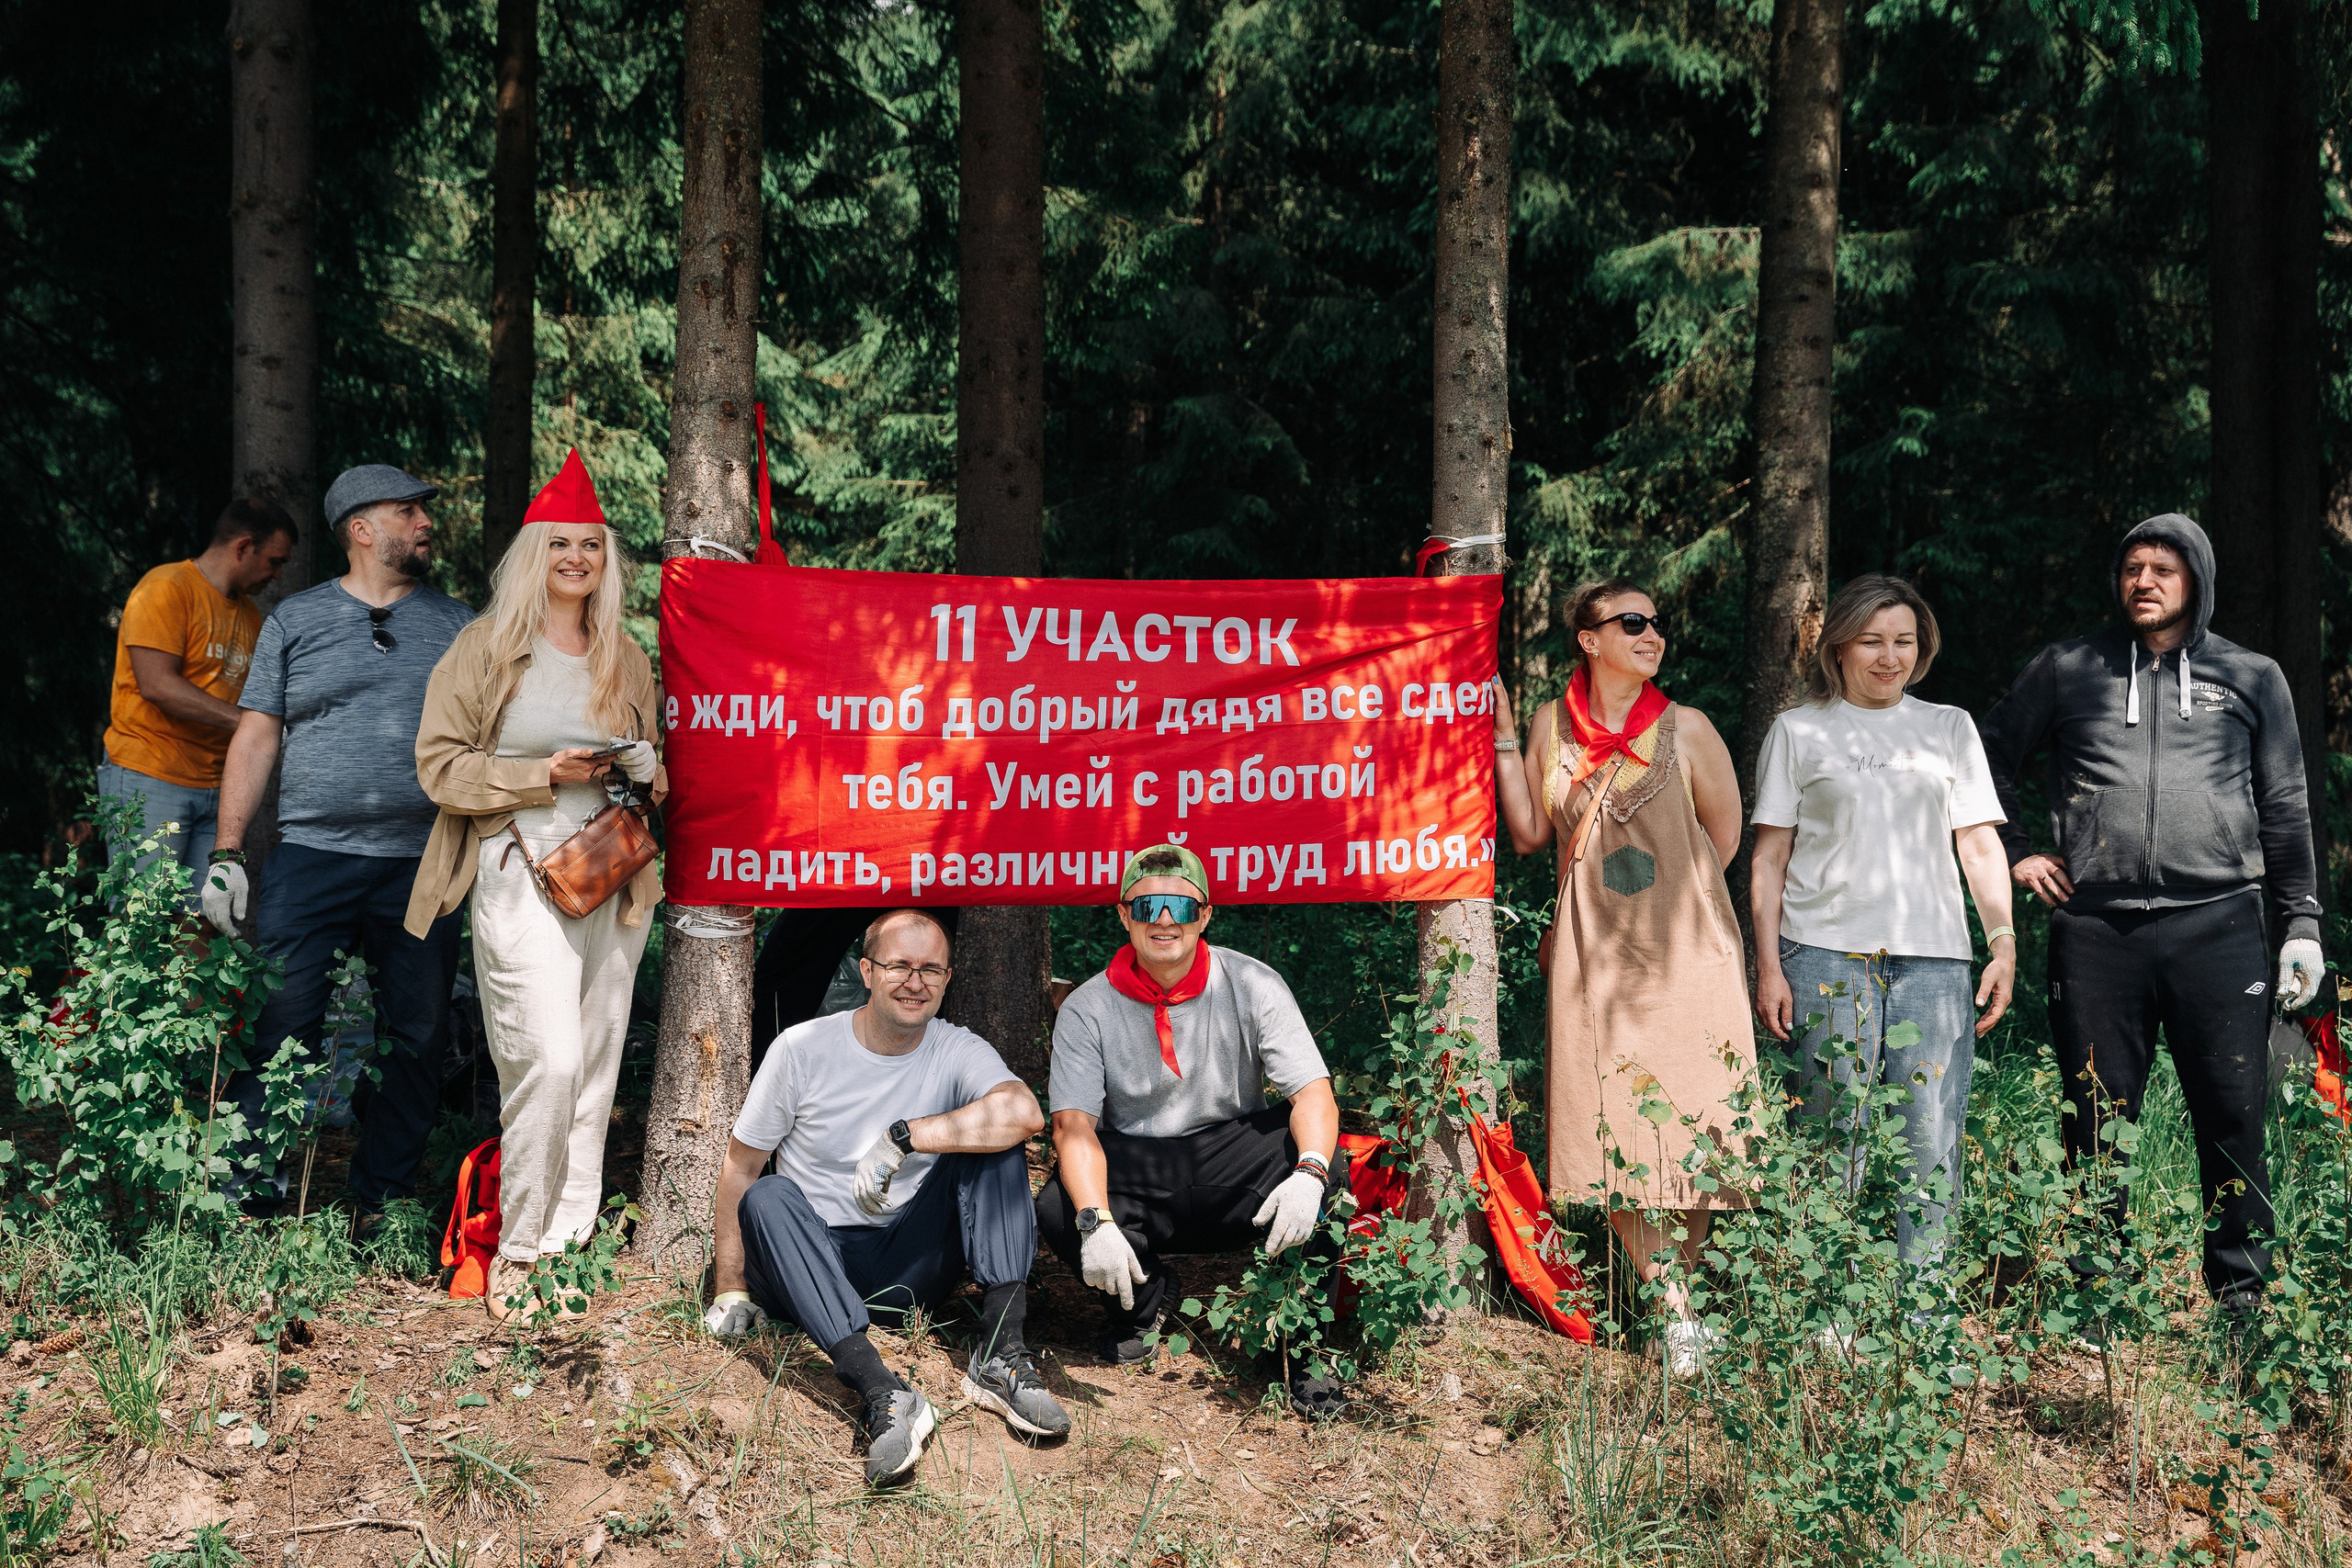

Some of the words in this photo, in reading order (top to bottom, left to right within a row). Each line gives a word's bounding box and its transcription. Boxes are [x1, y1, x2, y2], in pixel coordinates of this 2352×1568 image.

[931, 604, 976, 661] 11
[1002, 606, 1300, 666] УЧАСТОК
[690, 694, 797, 739] жди,
[817, 684, 924, 732] чтоб
[942, 681, 1138, 743] добрый
[1157, 694, 1282, 736] дядя
[1302, 682, 1383, 722] все
[842, 762, 967, 810] тебя.
[986, 756, 1112, 810] Умей
[1134, 772, 1159, 807] с
[1178, 746, 1375, 818] работой
[707, 848, 891, 895] ладить,
[911, 832, 1187, 897] различн
[1211, 843, 1326, 892] труд
[1344, 824, 1495, 875] любя.»
